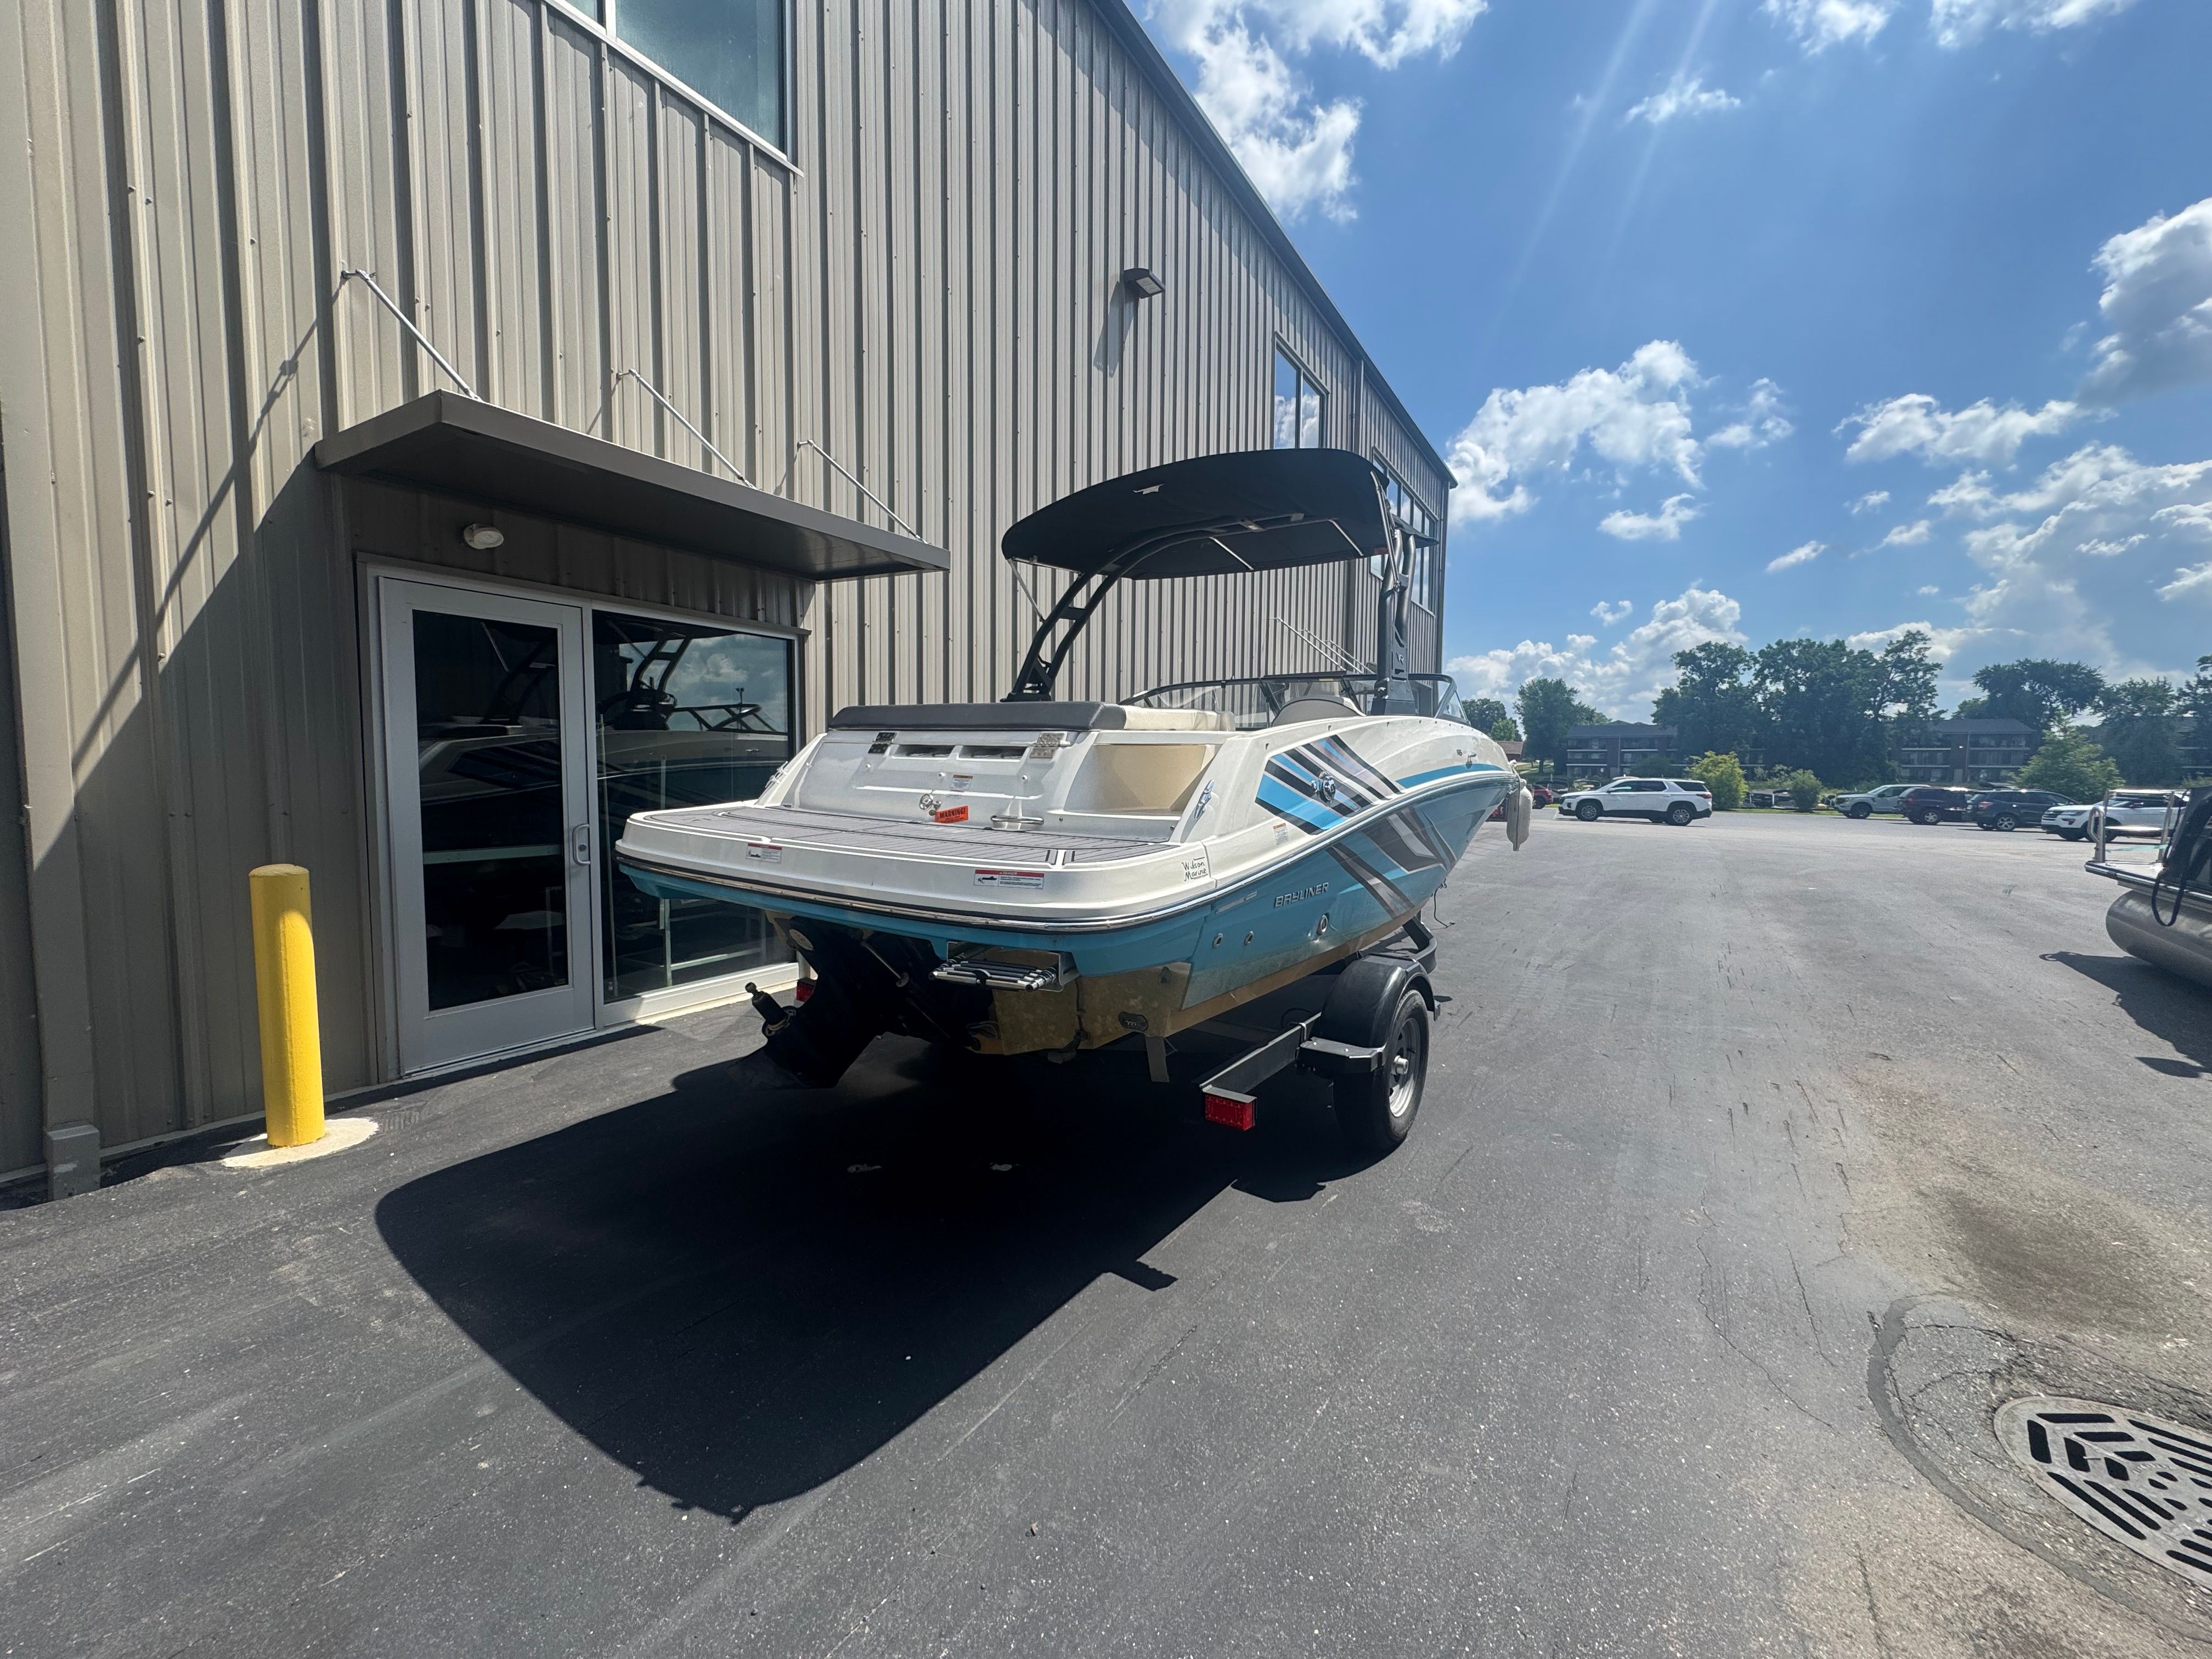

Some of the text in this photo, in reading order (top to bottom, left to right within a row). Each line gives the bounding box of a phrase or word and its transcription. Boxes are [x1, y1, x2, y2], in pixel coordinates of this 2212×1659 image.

[939, 807, 966, 819] WARNING!
[1181, 860, 1205, 871] Wilson
[1184, 868, 1207, 882] Marine
[1274, 882, 1329, 908] BAYLINER
